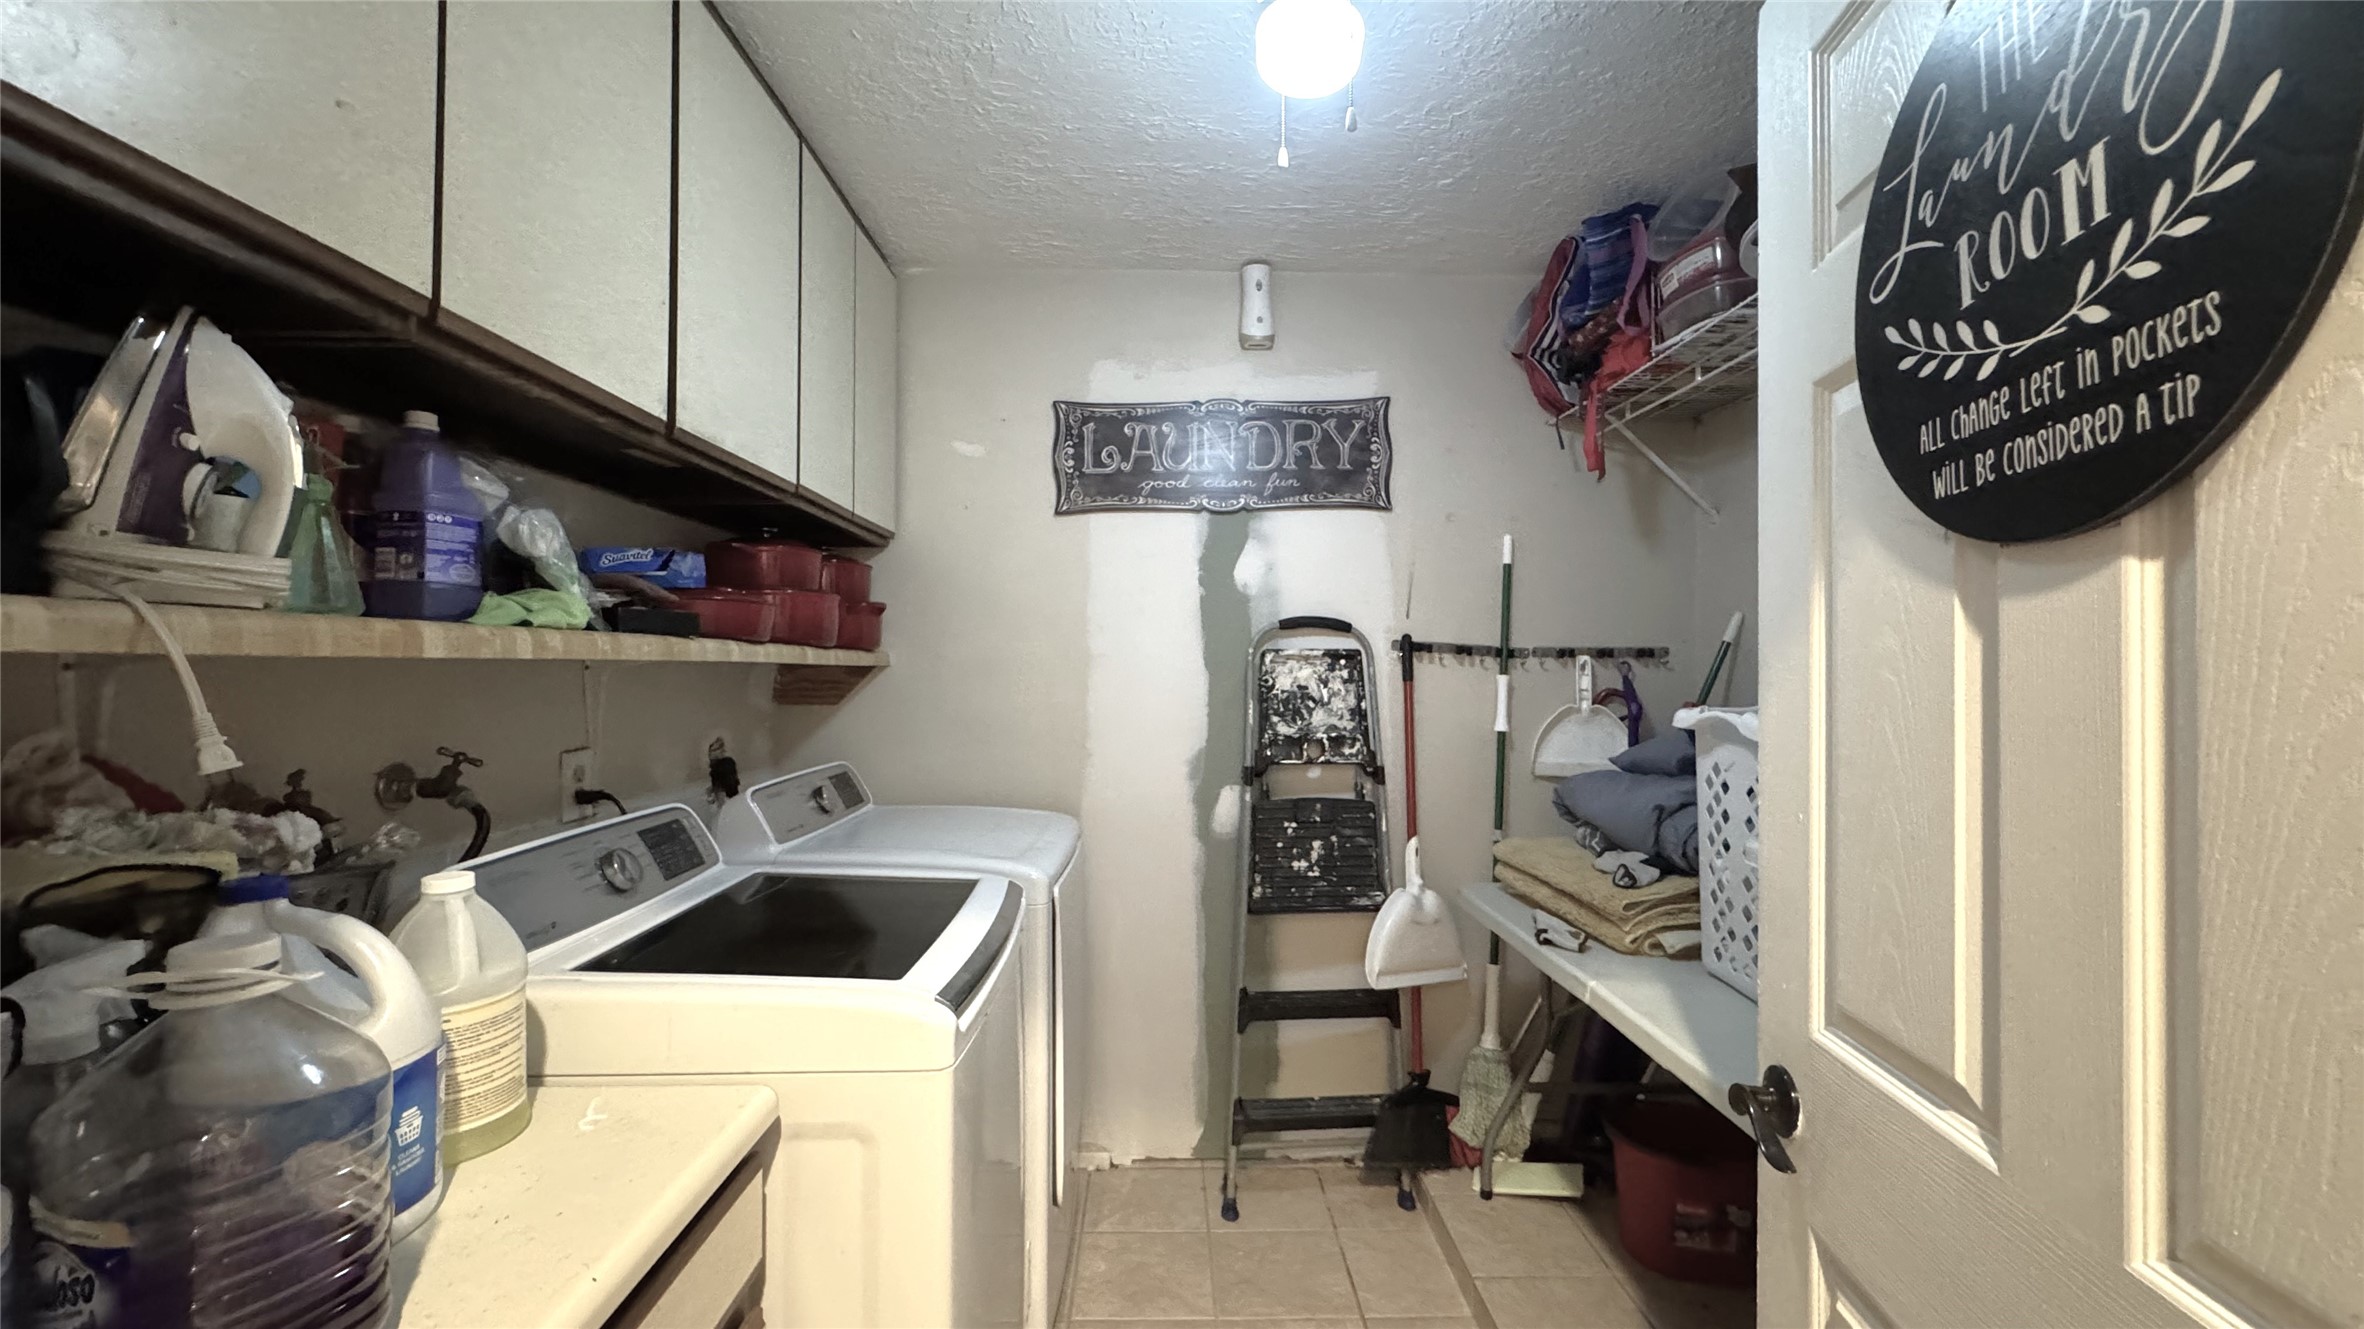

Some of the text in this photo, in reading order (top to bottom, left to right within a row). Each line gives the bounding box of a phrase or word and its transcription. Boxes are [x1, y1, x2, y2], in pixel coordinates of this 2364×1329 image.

[1970, 0, 2049, 112] THE
[1953, 136, 2112, 311] ROOM
[2136, 392, 2151, 434] A
[1083, 418, 1366, 473] LAUNDRY
[1920, 416, 1945, 455] ALL
[1138, 474, 1191, 496] good
[1264, 472, 1300, 496] fun
[602, 549, 653, 566] Suavitel
